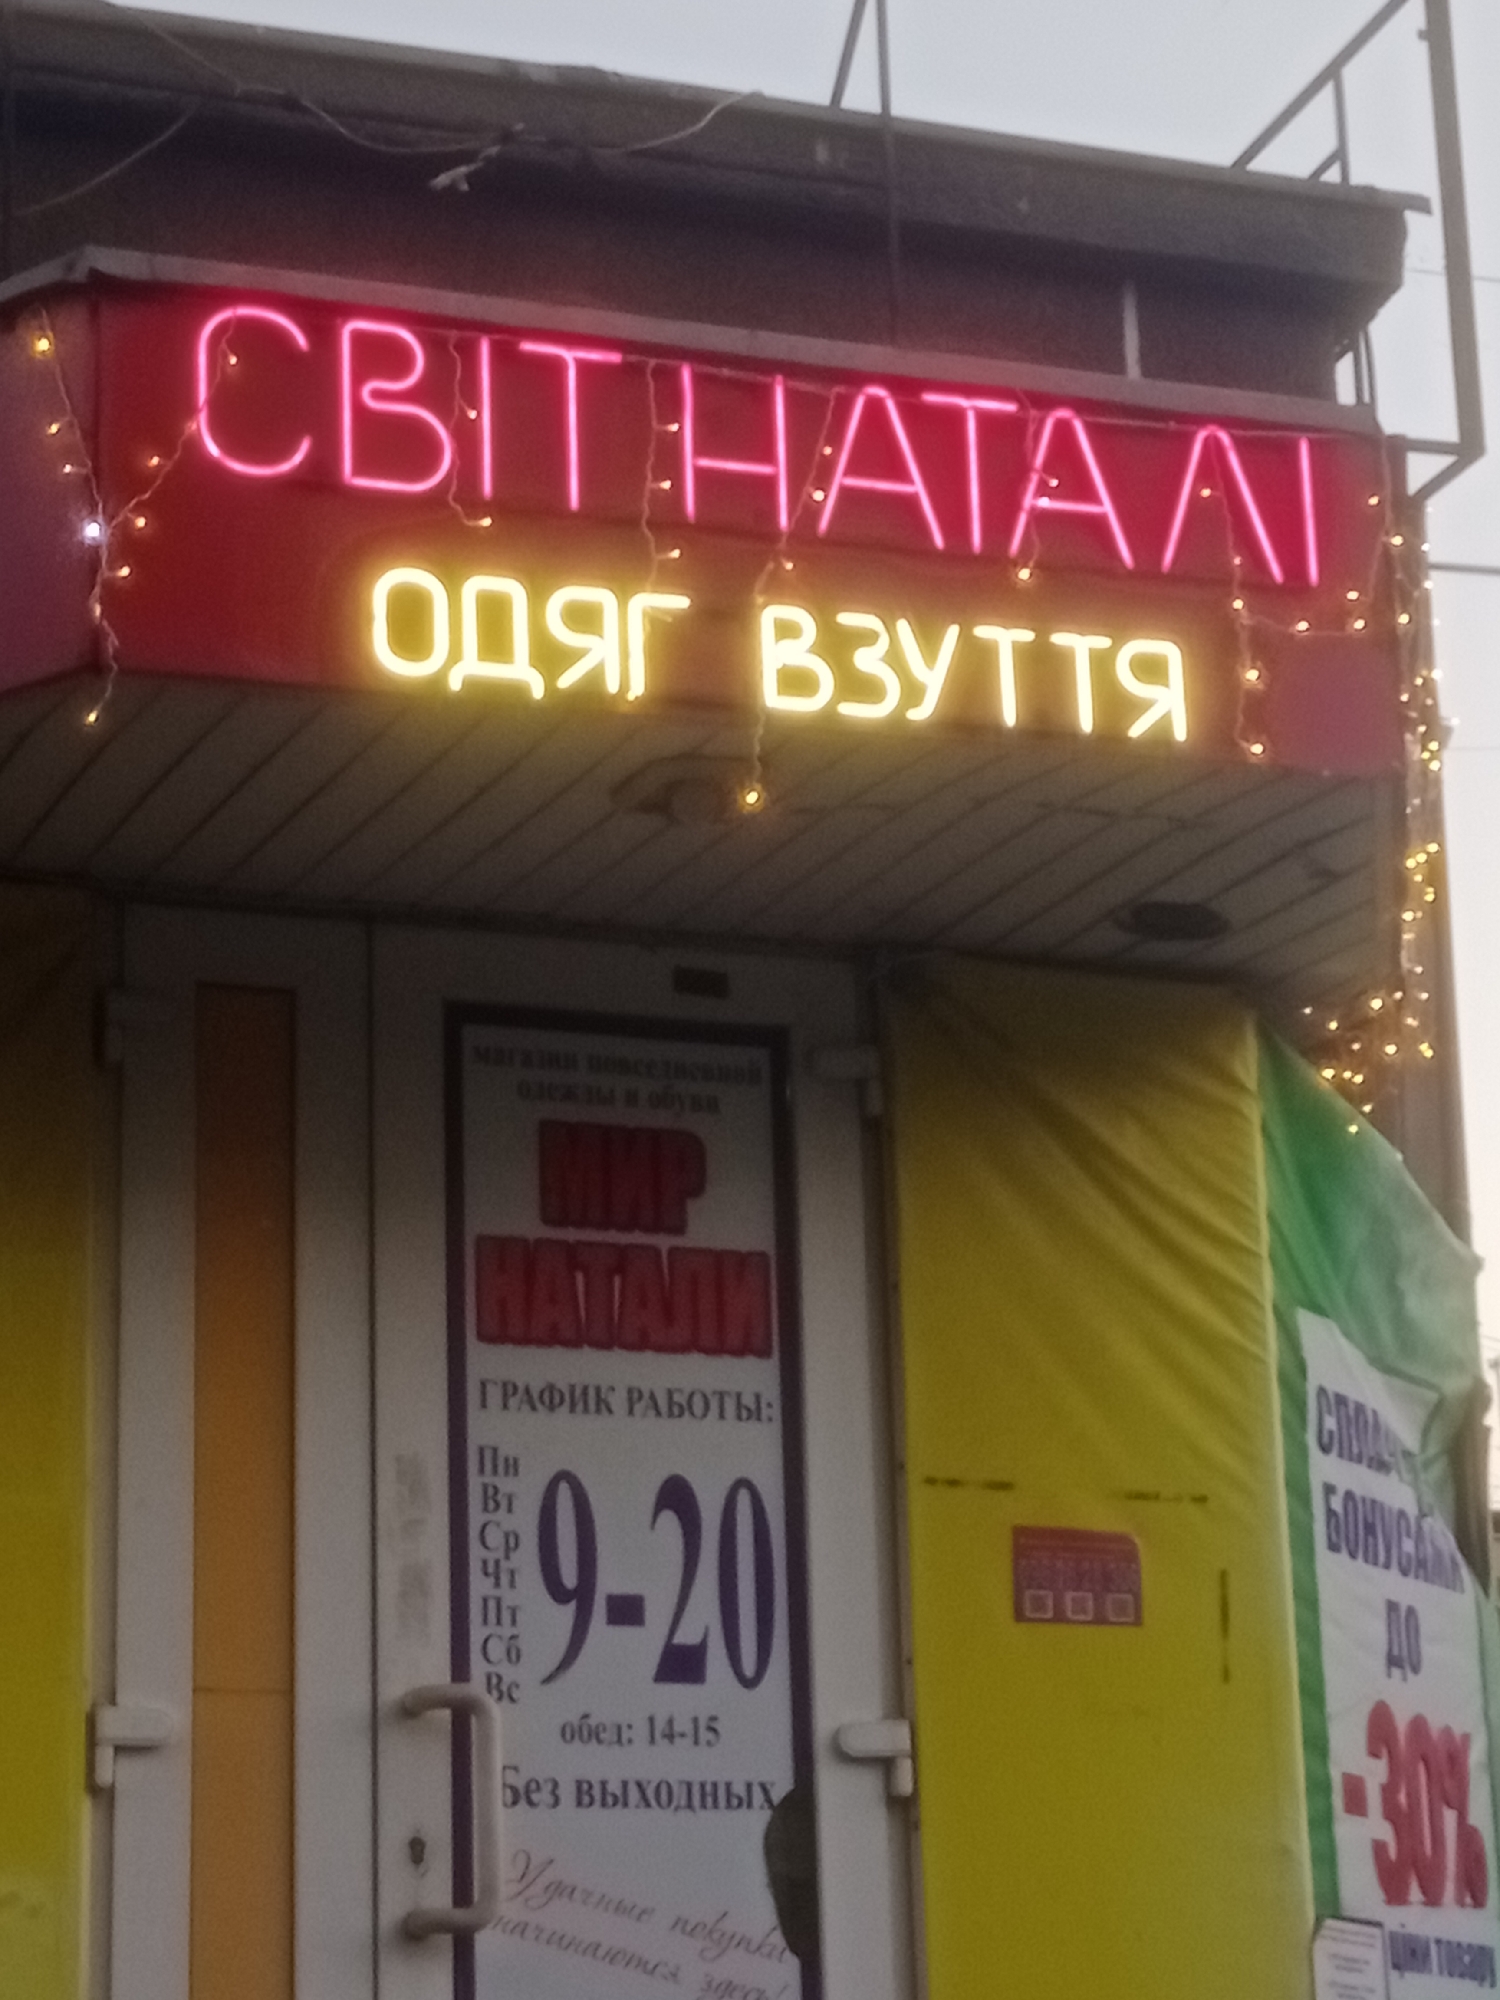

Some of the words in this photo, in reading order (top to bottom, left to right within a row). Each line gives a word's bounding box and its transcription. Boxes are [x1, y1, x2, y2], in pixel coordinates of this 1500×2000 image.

[196, 304, 623, 513] СВІТ
[681, 360, 1319, 586] НАТАЛІ
[371, 566, 692, 701] ОДЯГ
[760, 603, 1188, 742] ВЗУТТЯ
[538, 1119, 707, 1236] МИР
[475, 1234, 773, 1359] НАТАЛИ
[478, 1378, 616, 1417] ГРАФИК
[626, 1386, 774, 1423] РАБОТЫ:
[477, 1445, 521, 1478] Пн
[481, 1482, 516, 1515] Вт
[479, 1520, 521, 1561] Ср
[480, 1558, 517, 1590] Чт
[537, 1468, 776, 1690] 9-20
[481, 1596, 521, 1628] Пт
[481, 1633, 522, 1666] Сб
[485, 1672, 521, 1704] Вс
[560, 1712, 634, 1748] обед:
[646, 1713, 721, 1749] 14-15
[501, 1765, 561, 1811] Без
[574, 1778, 777, 1814] выходных
[1341, 1699, 1489, 1910] -30%
